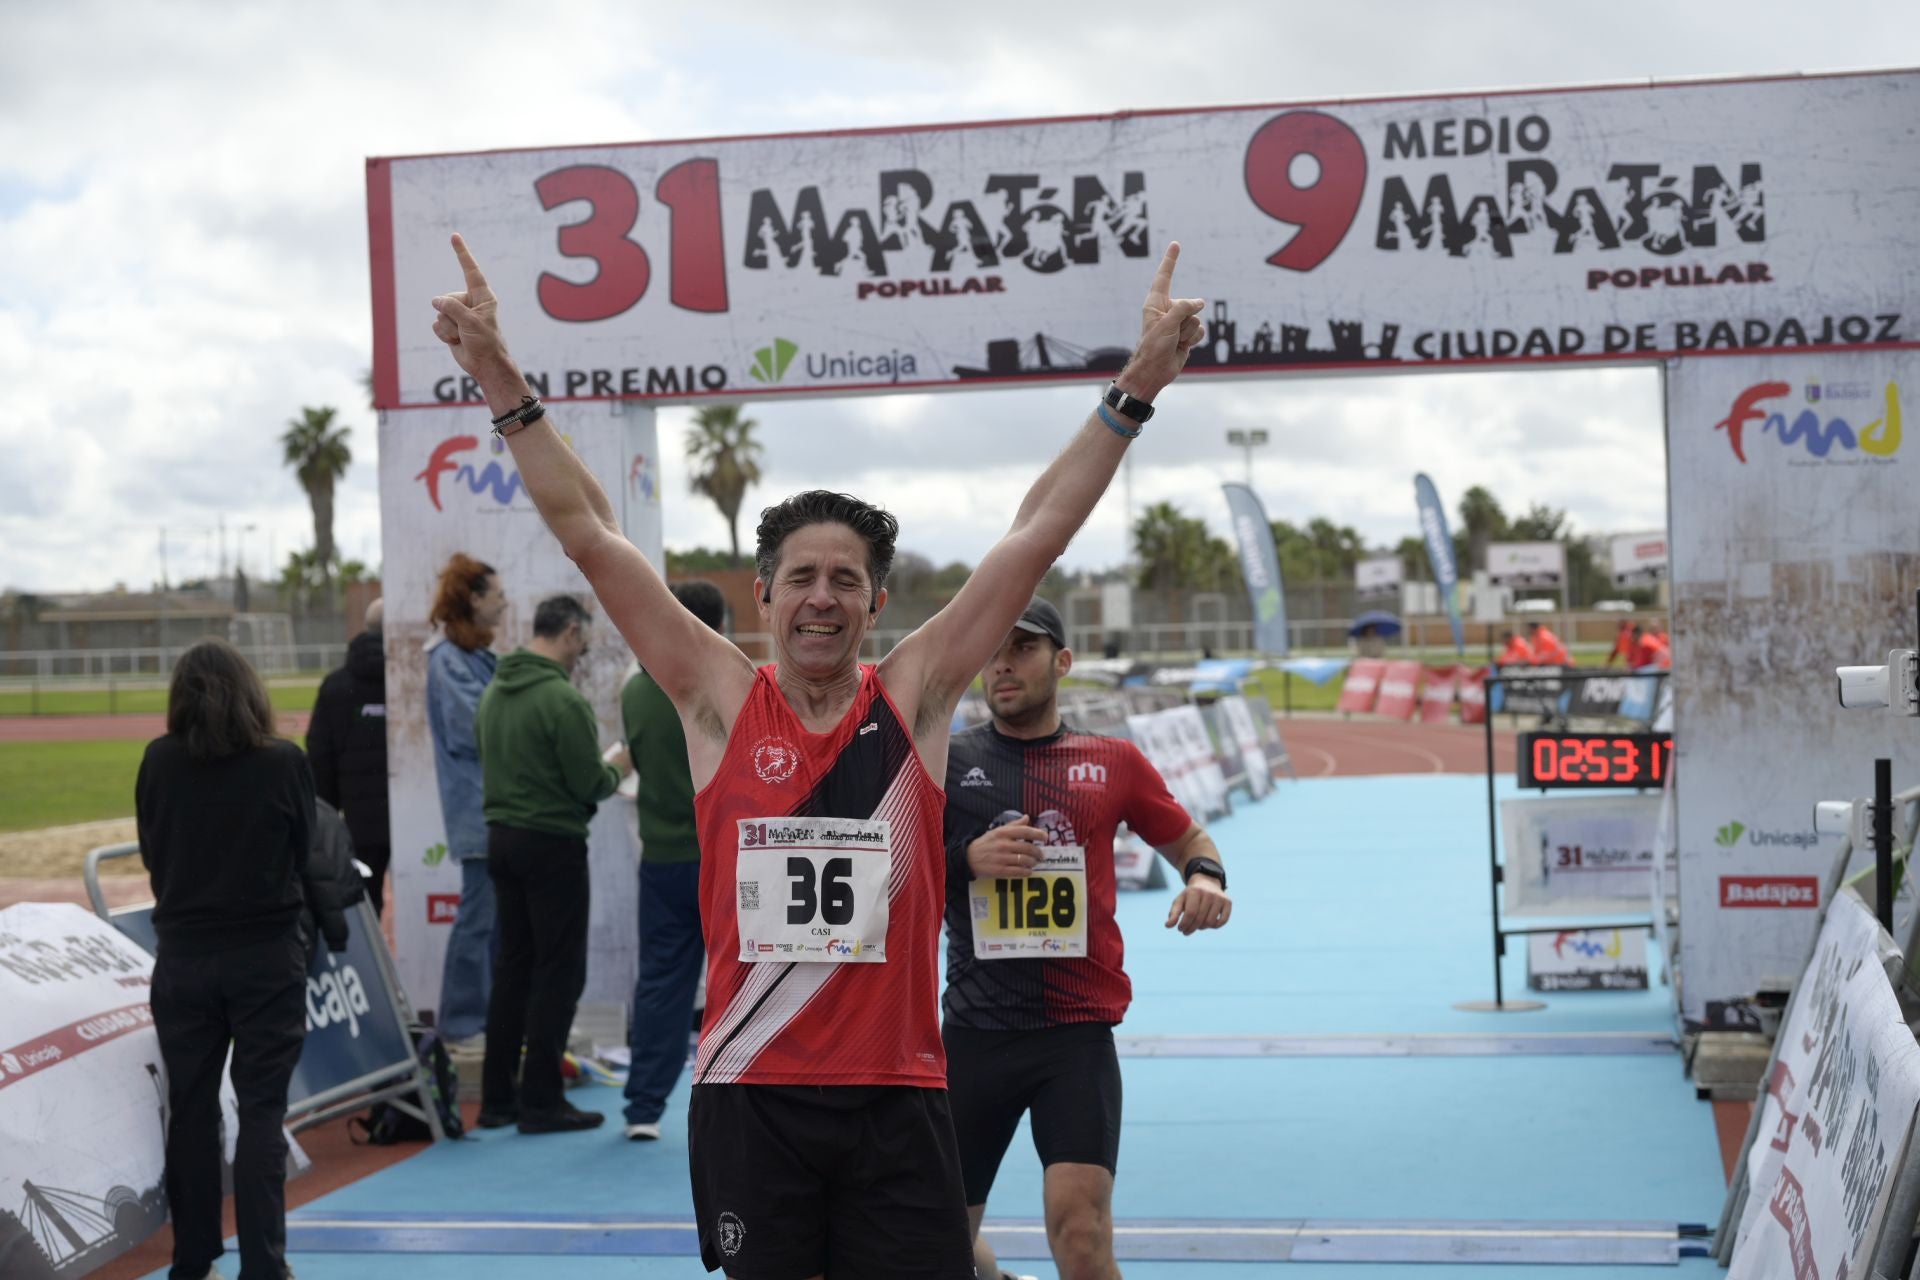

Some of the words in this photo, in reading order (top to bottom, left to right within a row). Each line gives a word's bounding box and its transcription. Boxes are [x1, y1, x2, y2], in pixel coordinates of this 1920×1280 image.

[1384, 115, 1551, 160] MEDIO
[1244, 110, 1367, 272] 9
[533, 157, 729, 322] 31
[858, 276, 1005, 300] POPULAR
[1587, 263, 1772, 290] POPULAR
[1414, 327, 1584, 361] CIUDAD
[1604, 323, 1656, 353] DE
[1675, 313, 1901, 351] BADAJOZ
[434, 372, 548, 402] GRN
[566, 365, 727, 397] PREMIO
[807, 348, 917, 383] Unicaja
[744, 824, 766, 846] 31
[1749, 829, 1818, 851] Unicaja
[1557, 846, 1581, 867] 31
[787, 857, 854, 925] 36
[995, 877, 1075, 929] 1128
[1725, 883, 1814, 906] Badajoz
[811, 928, 831, 936] CASI
[306, 953, 370, 1038] caja
